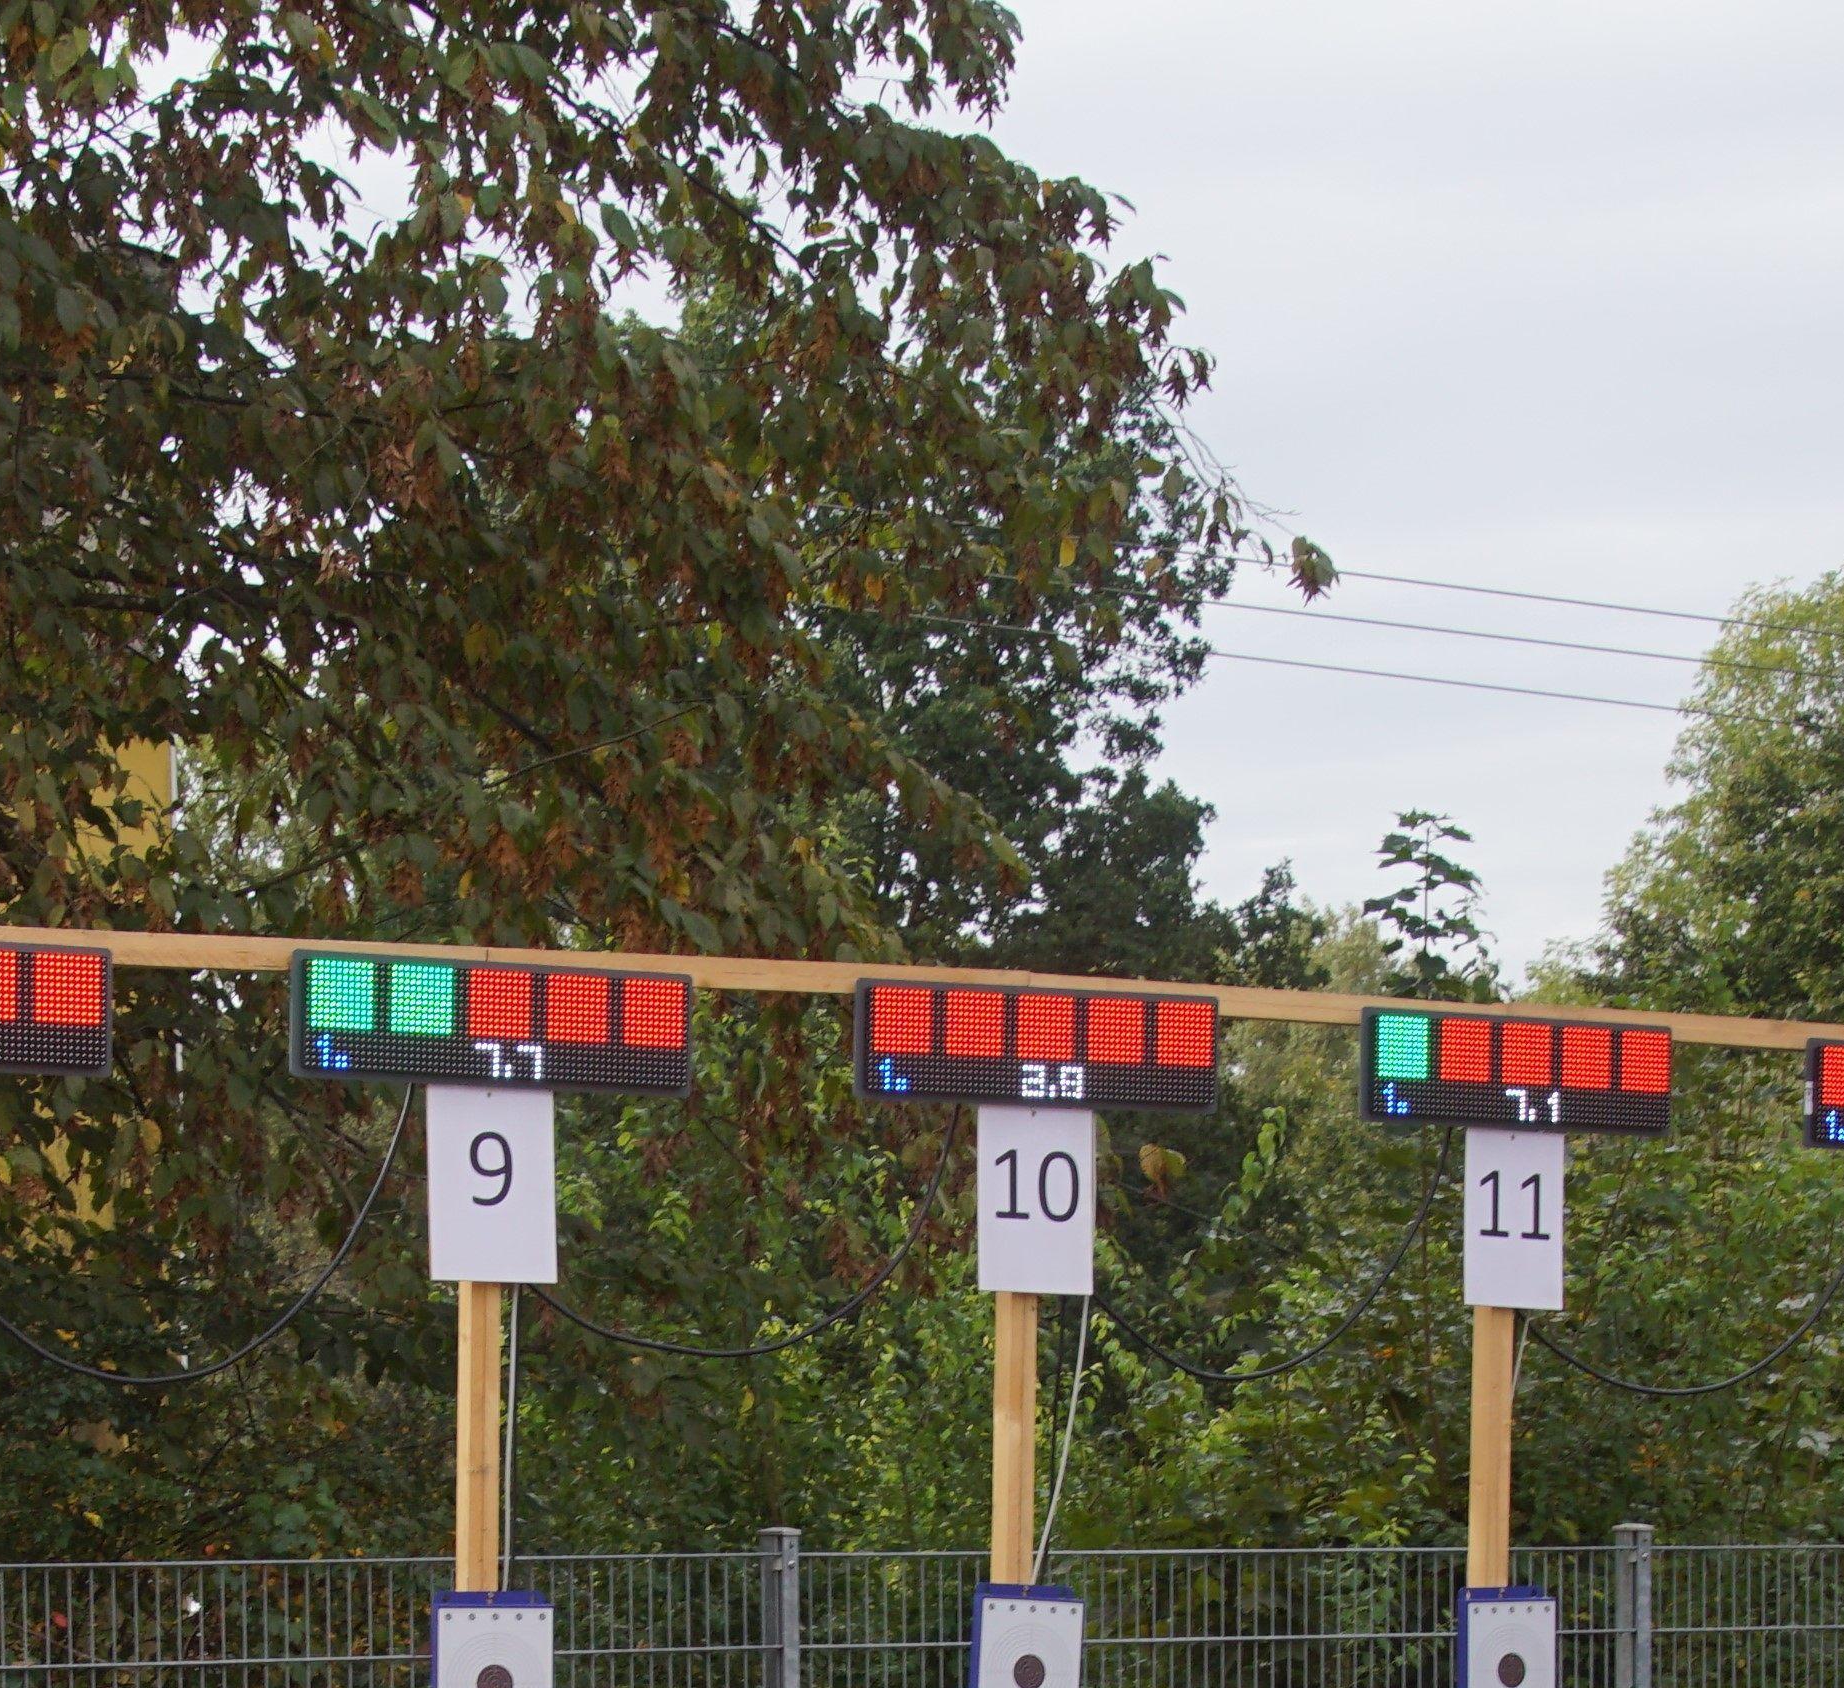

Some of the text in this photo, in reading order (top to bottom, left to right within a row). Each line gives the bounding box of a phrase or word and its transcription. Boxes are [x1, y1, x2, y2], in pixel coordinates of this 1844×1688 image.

[474, 1042, 543, 1080] 7.7
[1505, 1088, 1560, 1123] 7.1
[467, 1130, 515, 1206] 9
[994, 1148, 1080, 1223] 10
[1479, 1169, 1551, 1241] 11
